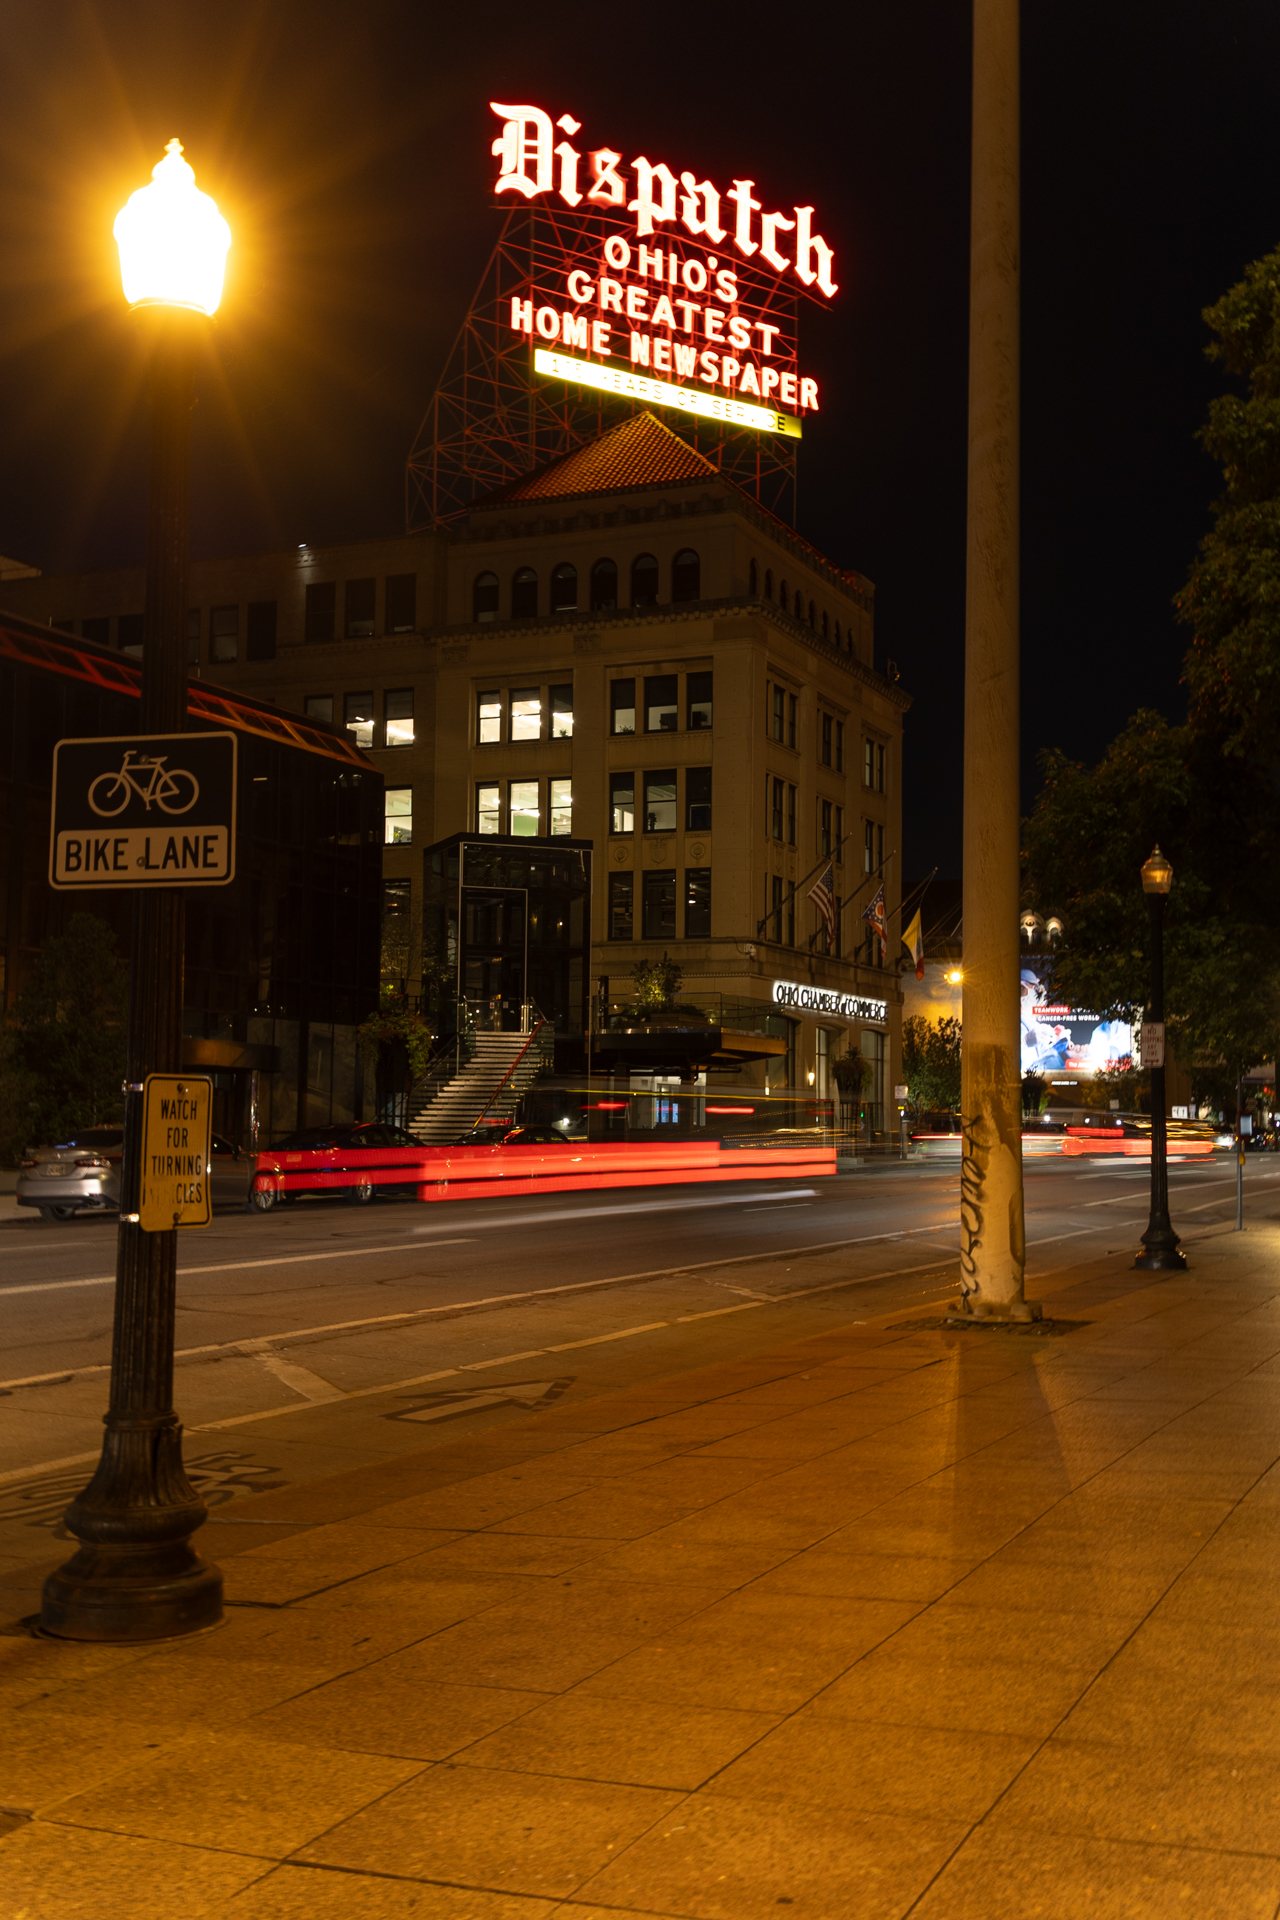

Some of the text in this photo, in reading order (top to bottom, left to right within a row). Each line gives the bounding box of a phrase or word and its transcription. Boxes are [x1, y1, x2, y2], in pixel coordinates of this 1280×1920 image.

[490, 101, 838, 298] Dispatch
[603, 235, 738, 302] OHIO'S
[567, 269, 779, 355] GREATEST
[511, 296, 819, 410] HOME NEWSPAPER
[600, 370, 664, 400] EARS
[65, 835, 218, 872] BIKE LANE
[777, 985, 800, 1006] OHIO
[801, 989, 841, 1014] CHAMBER
[848, 998, 888, 1021] COMMERCE
[1034, 1007, 1069, 1015] TEAMWORK
[160, 1098, 197, 1120] WATCH
[166, 1127, 188, 1148] FOR
[152, 1155, 201, 1177] TURNING
